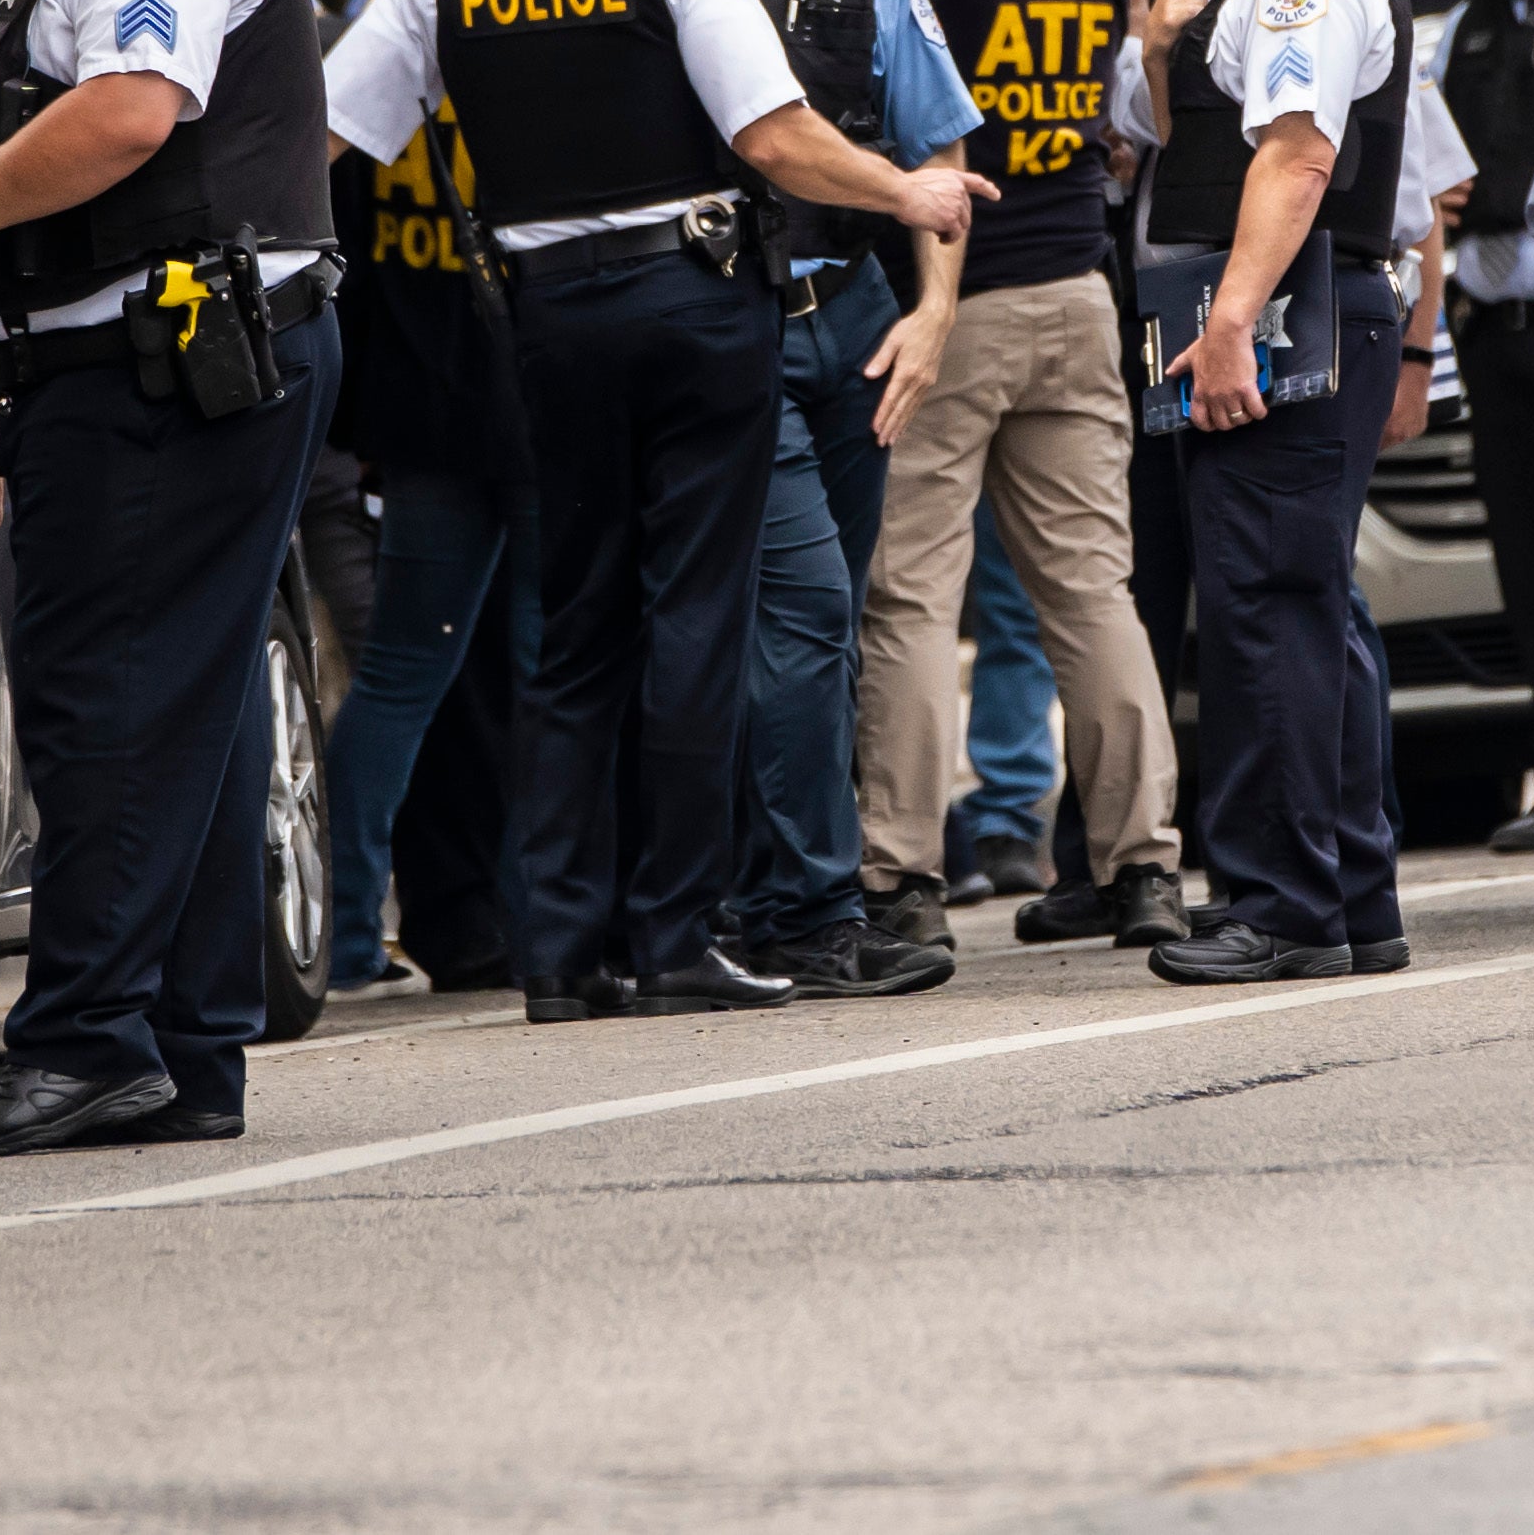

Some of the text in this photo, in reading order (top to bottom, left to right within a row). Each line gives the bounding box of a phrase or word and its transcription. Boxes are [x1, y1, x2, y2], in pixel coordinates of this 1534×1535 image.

[1266, 0, 1317, 23] POLICE
[975, 0, 1114, 77] ATF
[971, 81, 1104, 121] POLICE
[372, 212, 467, 272] POL
